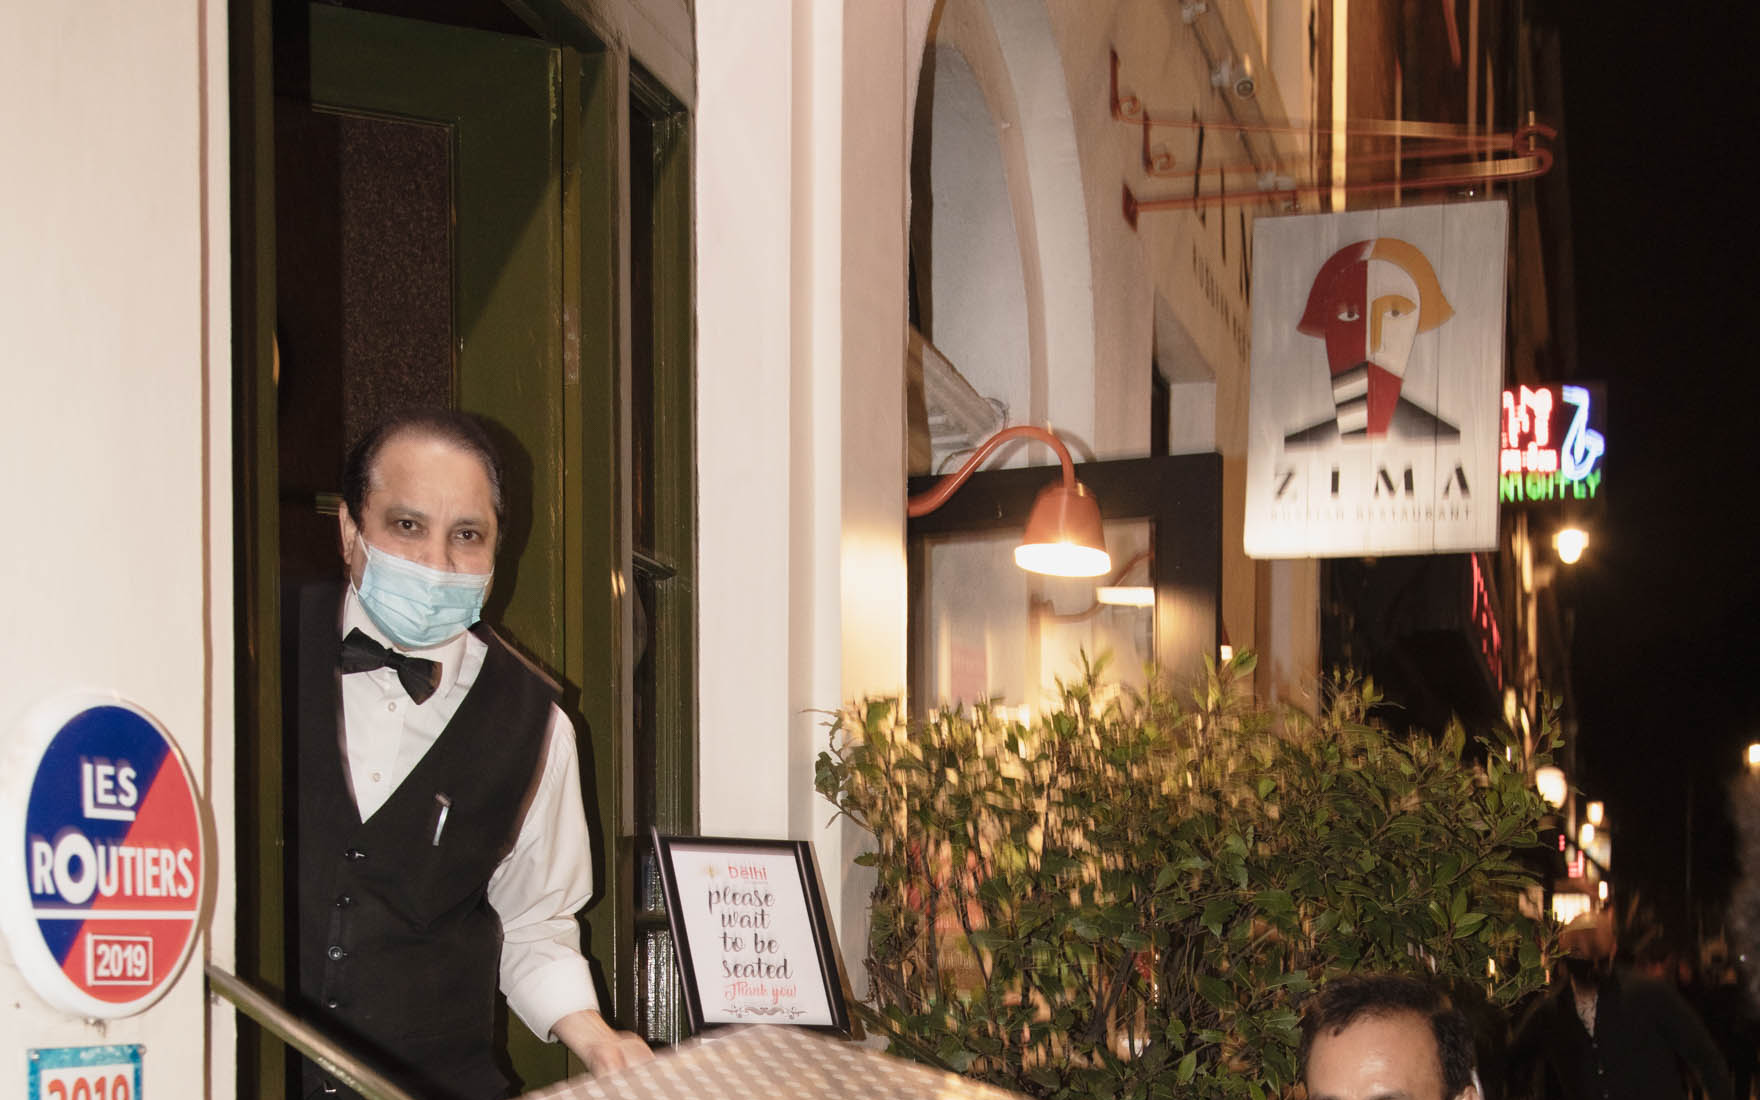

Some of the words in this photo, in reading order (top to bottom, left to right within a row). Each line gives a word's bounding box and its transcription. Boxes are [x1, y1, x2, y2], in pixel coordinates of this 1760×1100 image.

[1274, 463, 1471, 499] ZIMA
[83, 763, 138, 821] LES
[32, 833, 195, 904] ROUTIERS
[708, 885, 776, 915] please
[721, 909, 770, 930] wait
[720, 932, 745, 953] to
[754, 932, 780, 954] be
[96, 943, 148, 978] 2019
[721, 957, 794, 980] seated
